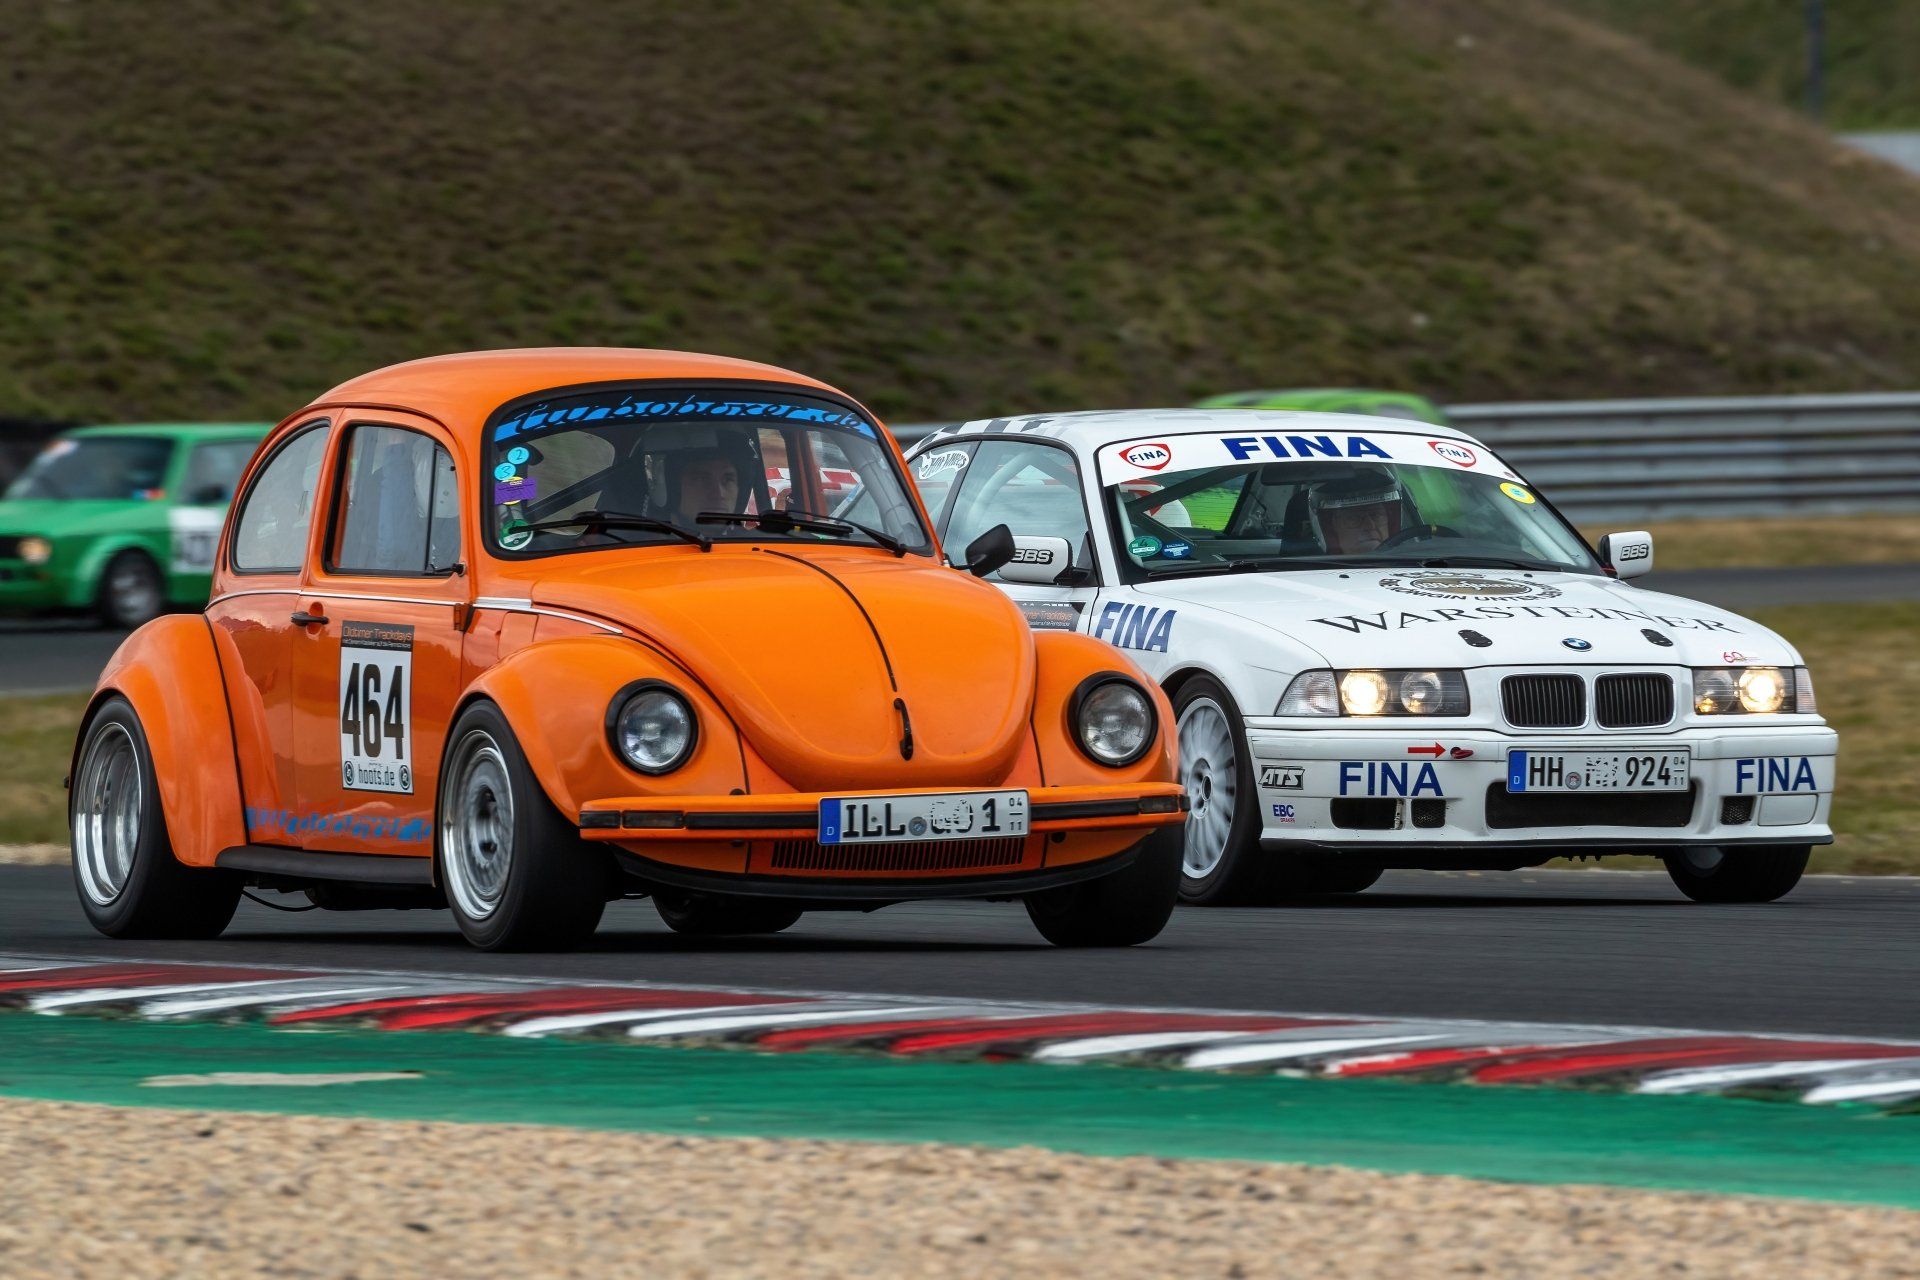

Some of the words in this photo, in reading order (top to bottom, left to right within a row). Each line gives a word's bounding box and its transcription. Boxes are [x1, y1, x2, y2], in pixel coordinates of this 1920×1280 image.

[1129, 450, 1167, 463] FINA
[1220, 436, 1394, 461] FINA
[1437, 446, 1471, 460] FINA
[1011, 548, 1054, 564] BBS
[1620, 544, 1649, 561] BBS
[1094, 601, 1178, 653] FINA
[1308, 605, 1742, 635] WARSTEINER
[341, 662, 404, 760] 464
[1259, 767, 1304, 787] ATS
[1339, 761, 1444, 797] FINA
[1529, 756, 1564, 787] HH
[1625, 755, 1671, 787] 924
[1735, 757, 1817, 794] FINA
[1008, 797, 1023, 807] 04
[1272, 804, 1295, 818] EBC
[842, 802, 906, 839] ILL
[981, 797, 1001, 833] 1
[826, 826, 835, 836] D
